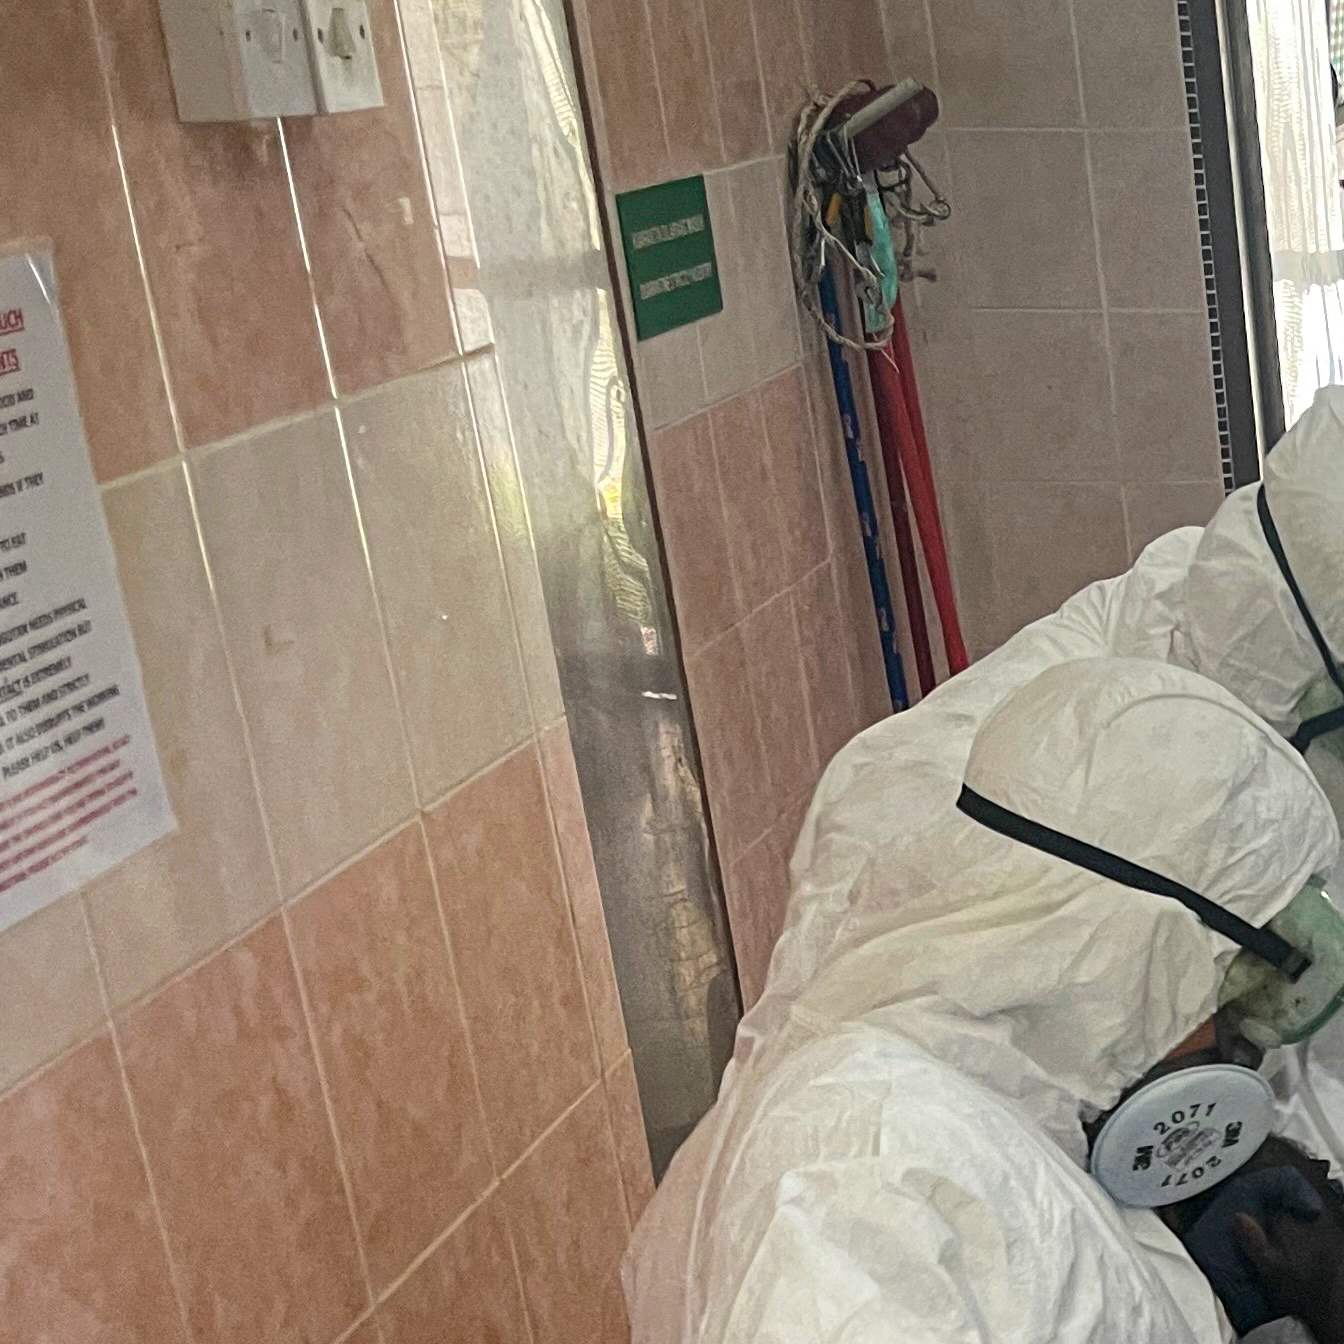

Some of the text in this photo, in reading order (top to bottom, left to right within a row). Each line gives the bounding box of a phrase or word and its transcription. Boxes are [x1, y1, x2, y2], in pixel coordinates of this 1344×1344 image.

[1153, 1102, 1217, 1136] 2071
[1222, 1121, 1243, 1148] 3M
[1132, 1145, 1154, 1171] 3M
[1160, 1155, 1222, 1188] 2071
